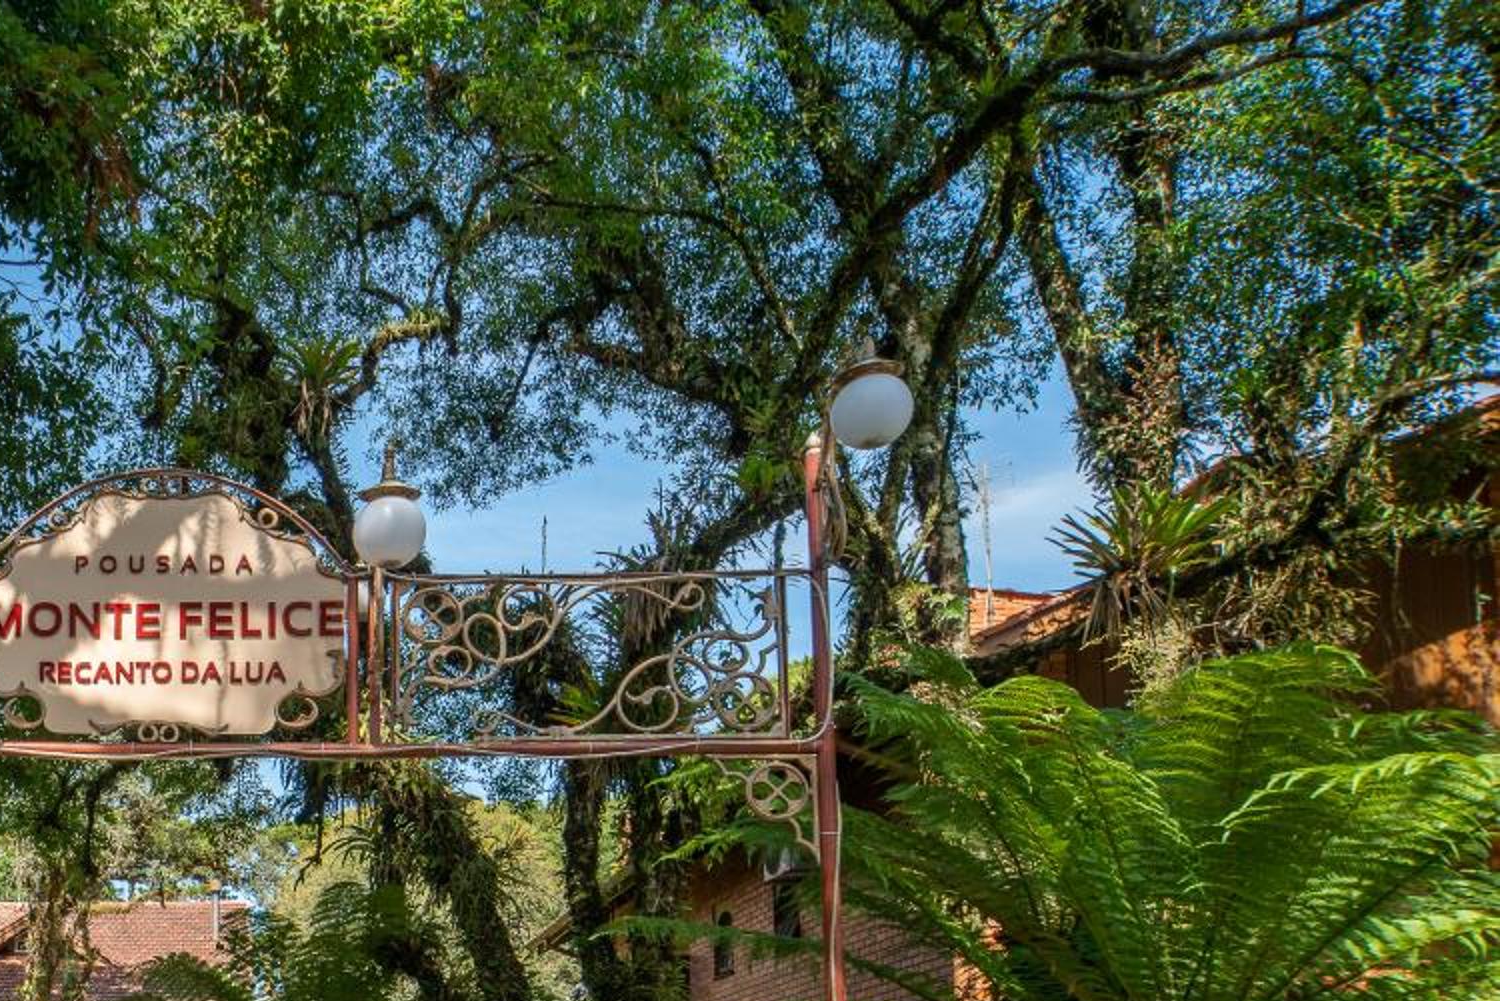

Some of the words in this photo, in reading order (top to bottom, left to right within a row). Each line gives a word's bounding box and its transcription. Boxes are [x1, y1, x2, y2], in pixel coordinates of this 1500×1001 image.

[75, 554, 253, 576] POUSADA
[179, 601, 345, 640] FELICE
[39, 660, 173, 686] RECANTO
[181, 660, 222, 686] DA
[229, 660, 287, 686] LUA
